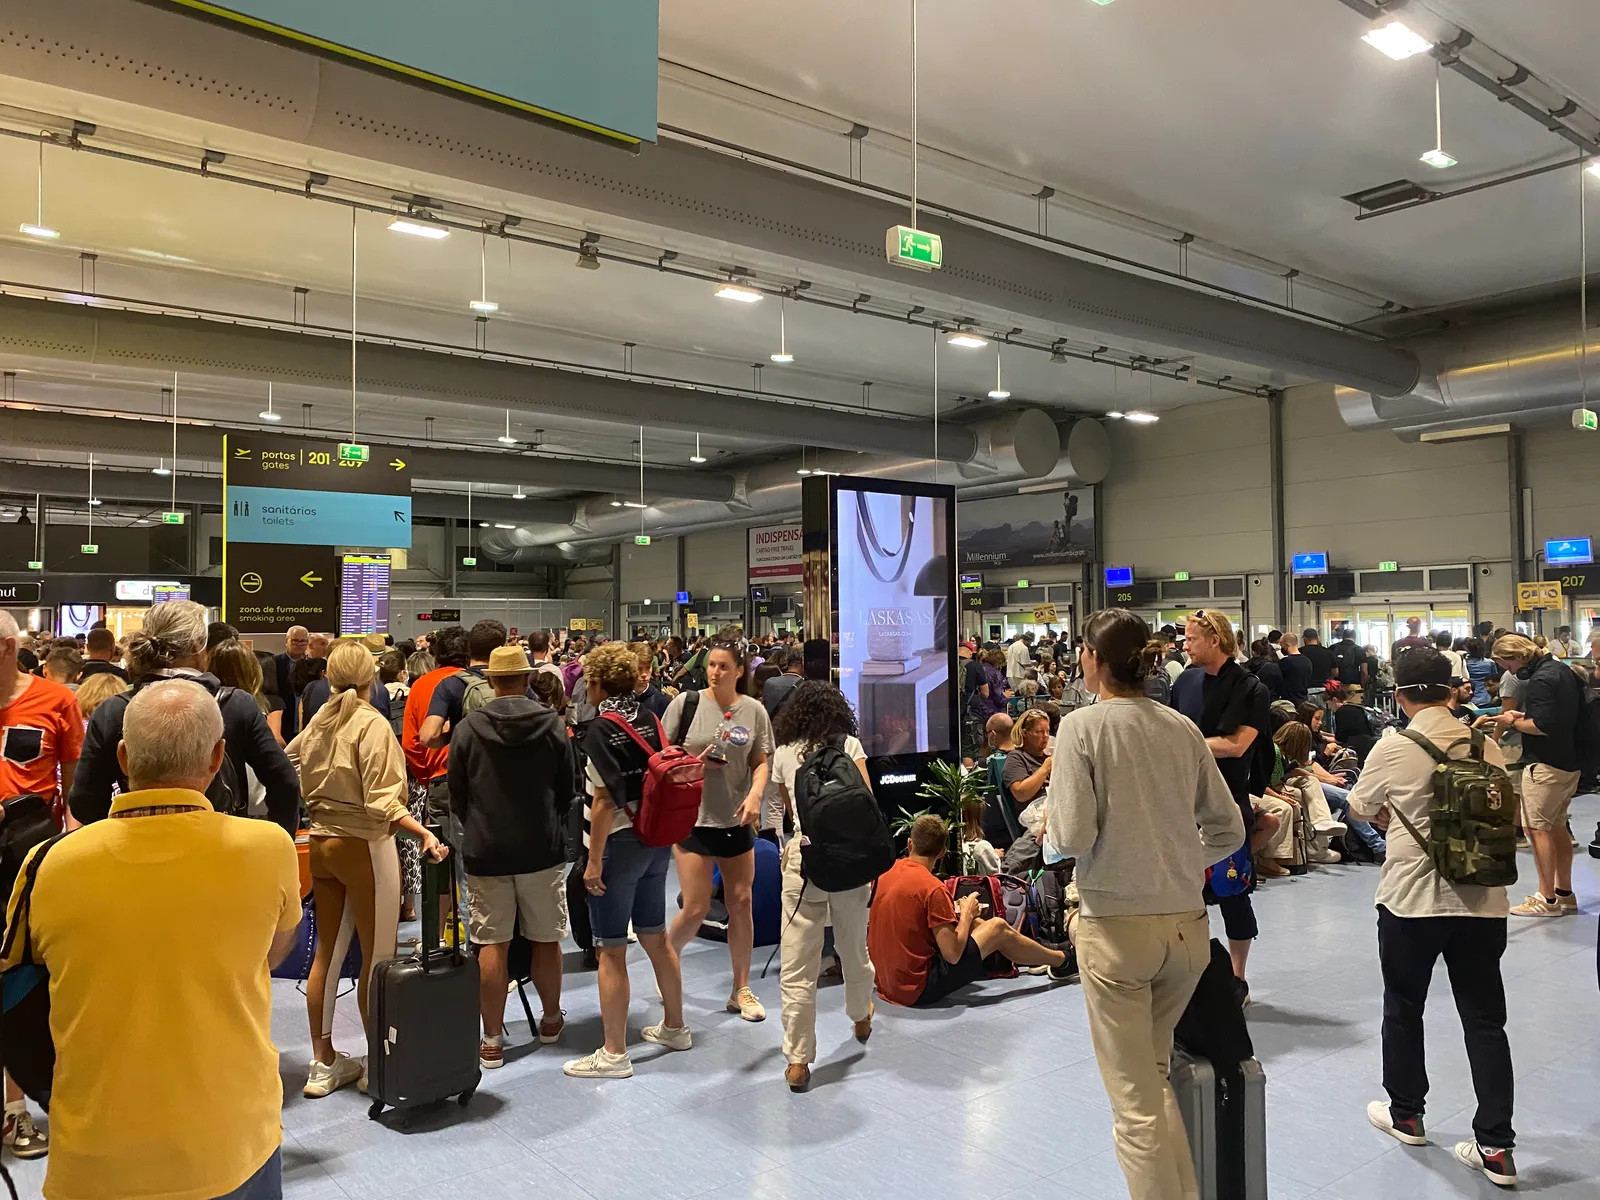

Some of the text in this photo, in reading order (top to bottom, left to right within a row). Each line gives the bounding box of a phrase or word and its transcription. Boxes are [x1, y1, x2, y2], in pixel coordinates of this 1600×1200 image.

[262, 451, 296, 460] portas
[308, 451, 330, 465] 201
[262, 461, 290, 470] gates
[261, 505, 317, 516] sanitários
[262, 516, 295, 526] toilets
[966, 552, 1007, 561] Millennium
[1562, 575, 1586, 587] 207
[1306, 584, 1325, 594] 206
[970, 597, 982, 606] 204
[1117, 592, 1132, 602] 205
[263, 605, 274, 613] de
[276, 605, 323, 613] fumadores
[239, 614, 275, 624] smoking
[859, 609, 931, 626] LASKASAS
[879, 774, 917, 785] JCDecaux
